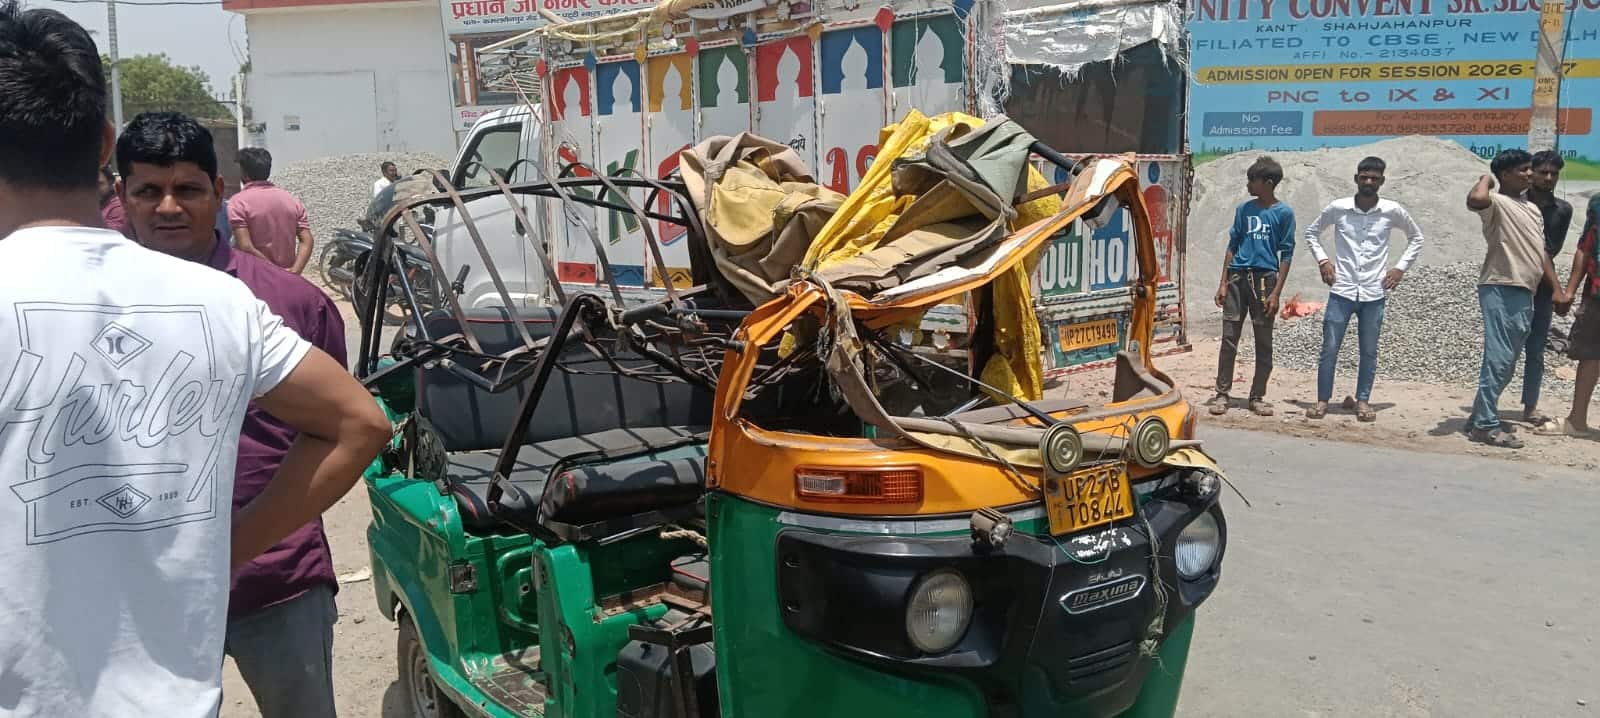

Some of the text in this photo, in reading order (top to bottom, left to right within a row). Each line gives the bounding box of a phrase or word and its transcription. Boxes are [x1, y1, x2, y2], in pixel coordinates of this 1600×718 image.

[1256, 19, 1472, 33] KANT SHAHJAHANPUR
[1196, 36, 1303, 51] FILIATED
[1321, 36, 1350, 48] TO
[1463, 31, 1519, 44] NEW
[1207, 69, 1289, 82] ADMISSION
[1295, 67, 1333, 80] OPEN
[1340, 66, 1371, 79] FOR
[1379, 64, 1460, 78] SESSION
[1267, 86, 1510, 103] PNC to IX & XI
[1241, 113, 1261, 122] No
[1403, 110, 1466, 121] Admission
[1208, 125, 1293, 135] Admission Fee
[1246, 215, 1271, 233] Dr.
[1040, 240, 1078, 291] OW
[0, 350, 249, 502] Hurley
[1066, 494, 1124, 528] T0844
